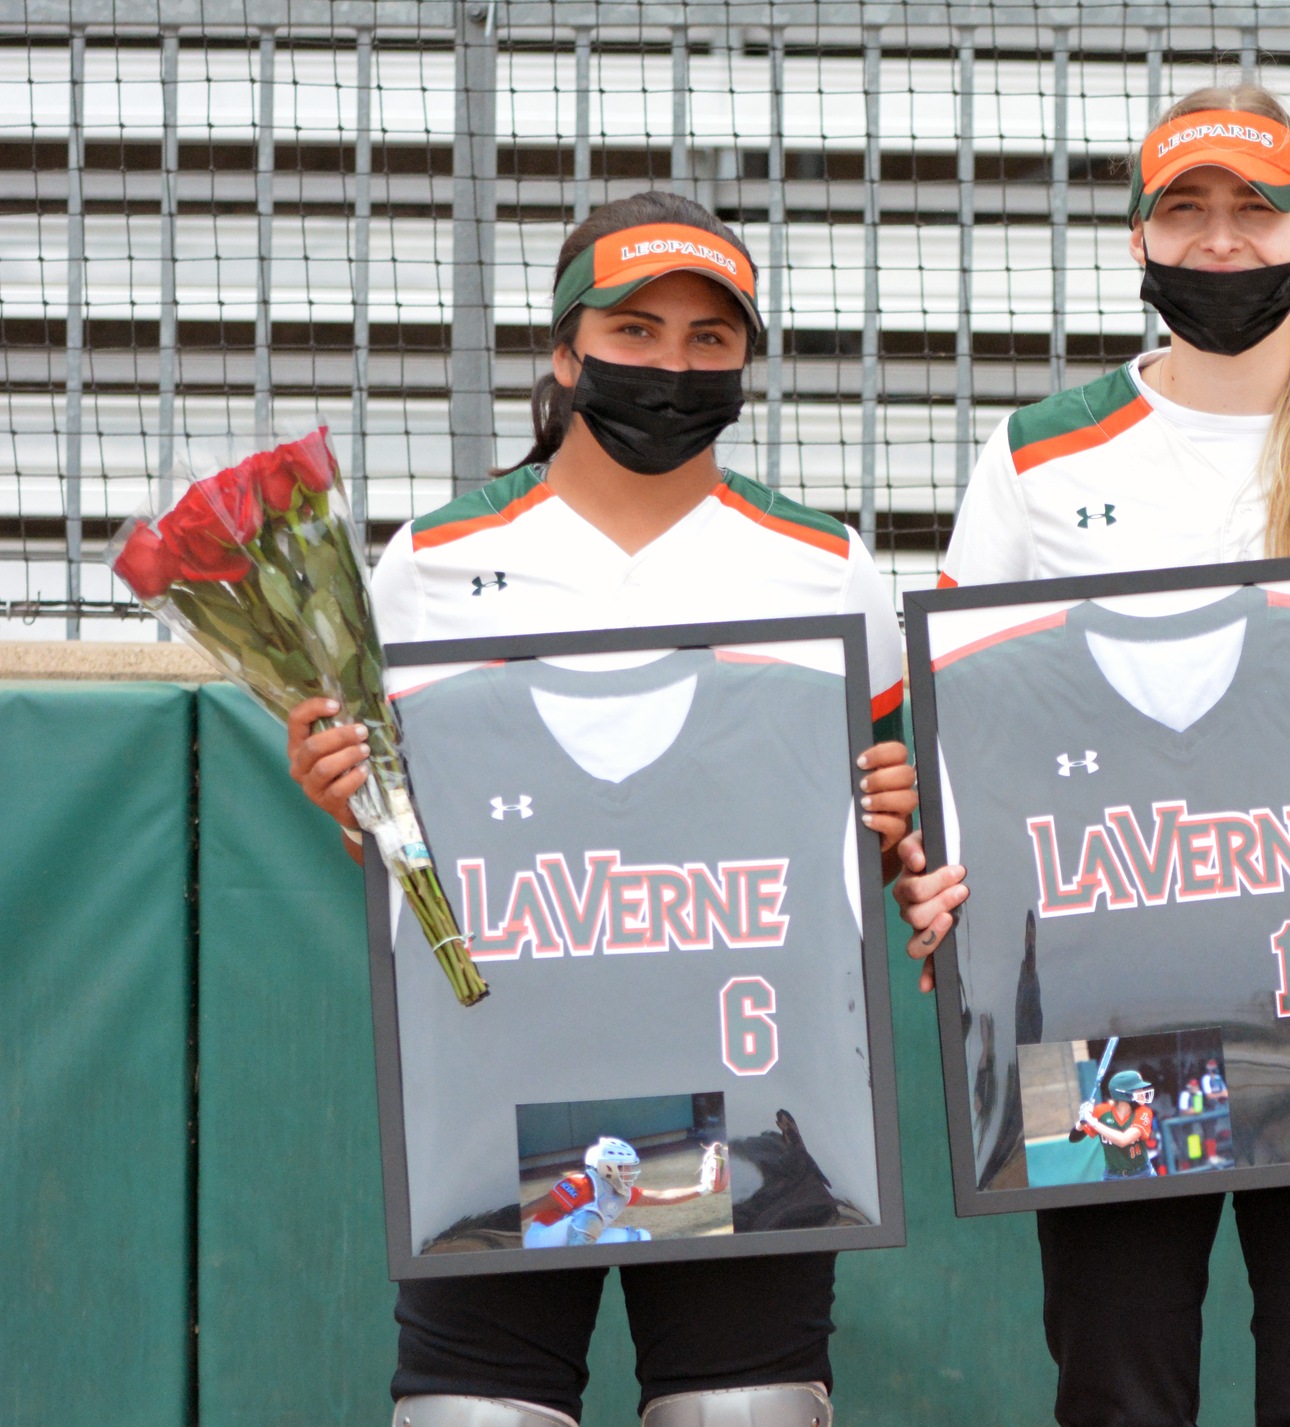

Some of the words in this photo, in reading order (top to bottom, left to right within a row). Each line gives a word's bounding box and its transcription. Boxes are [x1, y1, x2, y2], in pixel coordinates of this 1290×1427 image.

[1158, 123, 1274, 158] LEOPARDS
[621, 239, 738, 275] LEOPARDS
[719, 976, 779, 1077] 6
